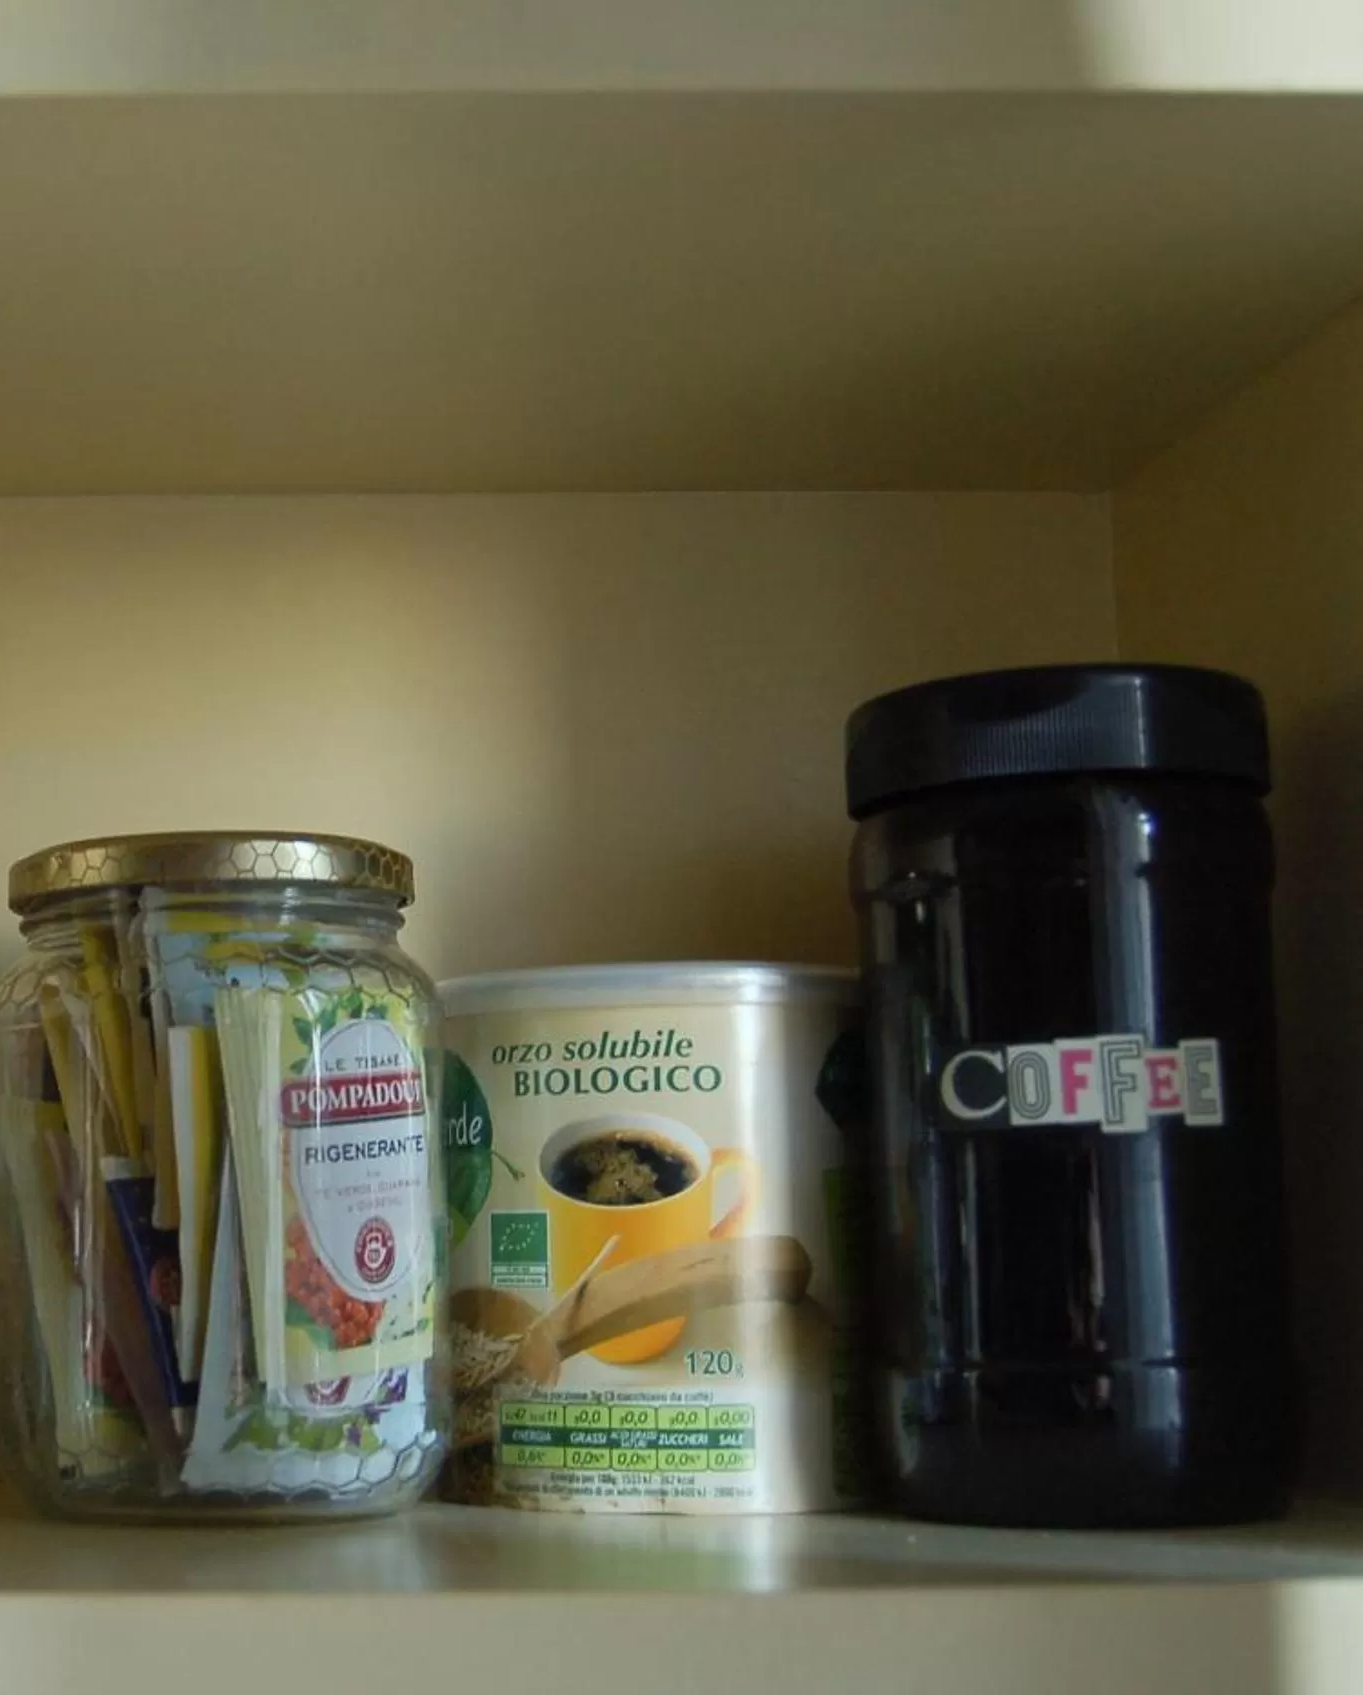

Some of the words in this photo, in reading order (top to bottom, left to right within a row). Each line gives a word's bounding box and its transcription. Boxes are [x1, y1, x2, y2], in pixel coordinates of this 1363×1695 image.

[325, 1057, 347, 1072] LE
[492, 1042, 552, 1065] orzo
[563, 1029, 694, 1061] solubile
[514, 1066, 722, 1097] BIOLOGICO
[941, 1039, 1219, 1124] COFFEE
[446, 1100, 484, 1146] rde
